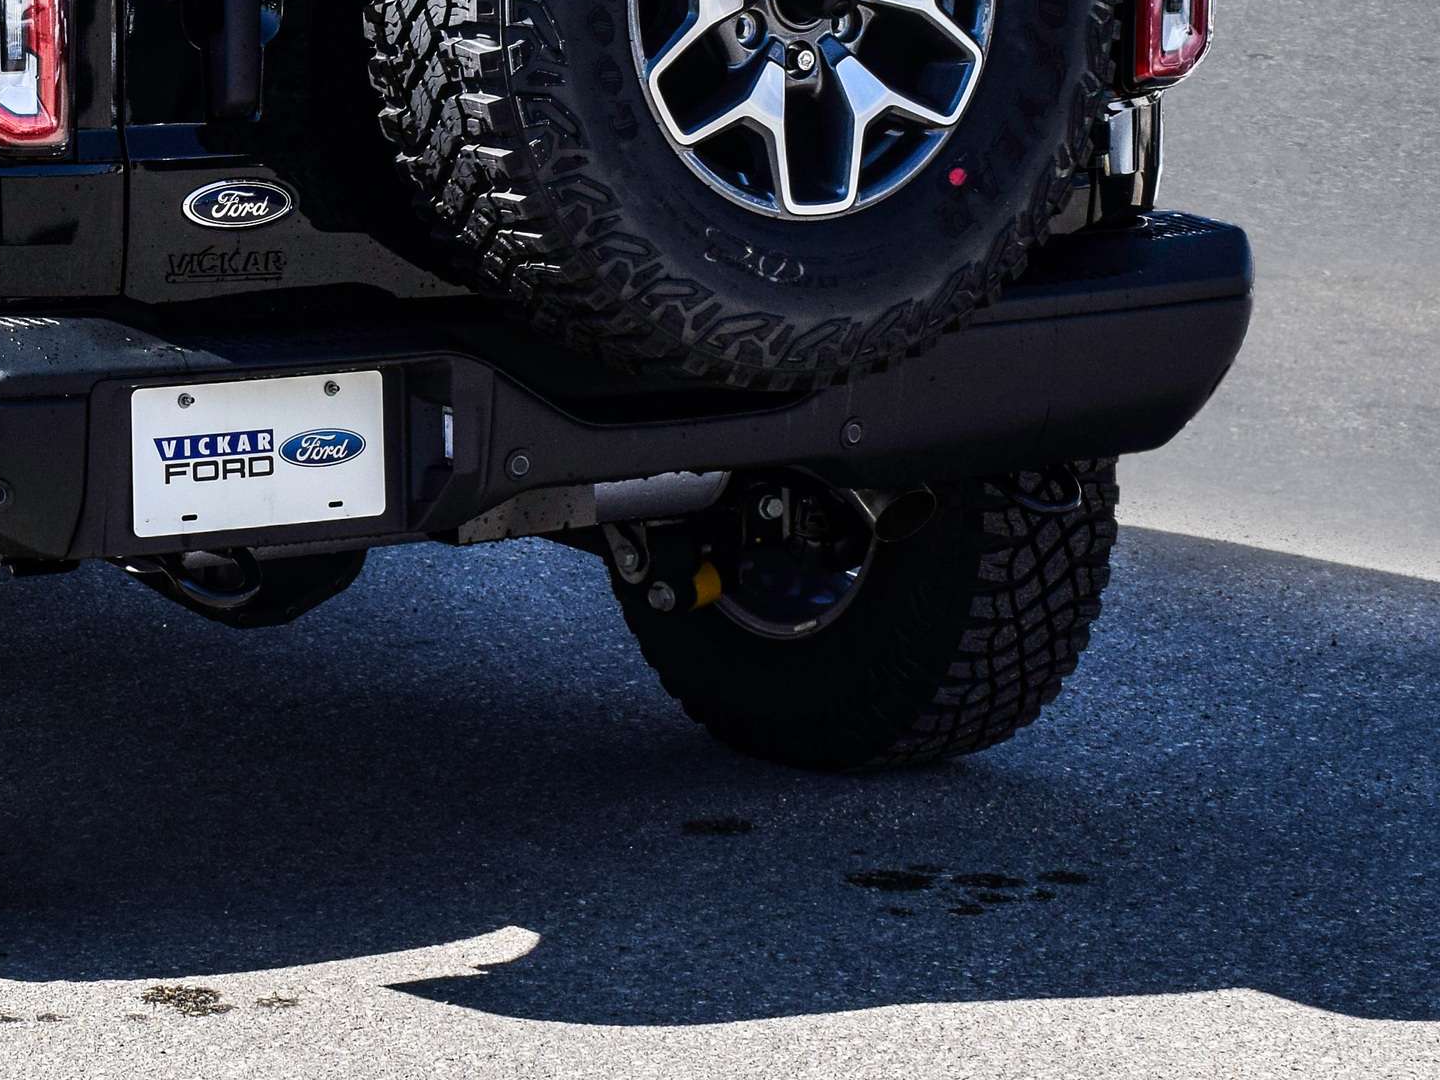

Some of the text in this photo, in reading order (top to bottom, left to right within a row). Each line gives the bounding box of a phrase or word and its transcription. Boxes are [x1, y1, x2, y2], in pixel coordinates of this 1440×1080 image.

[168, 246, 288, 275] VICKAR
[161, 432, 272, 458] VICKAR
[164, 457, 275, 485] FORD
